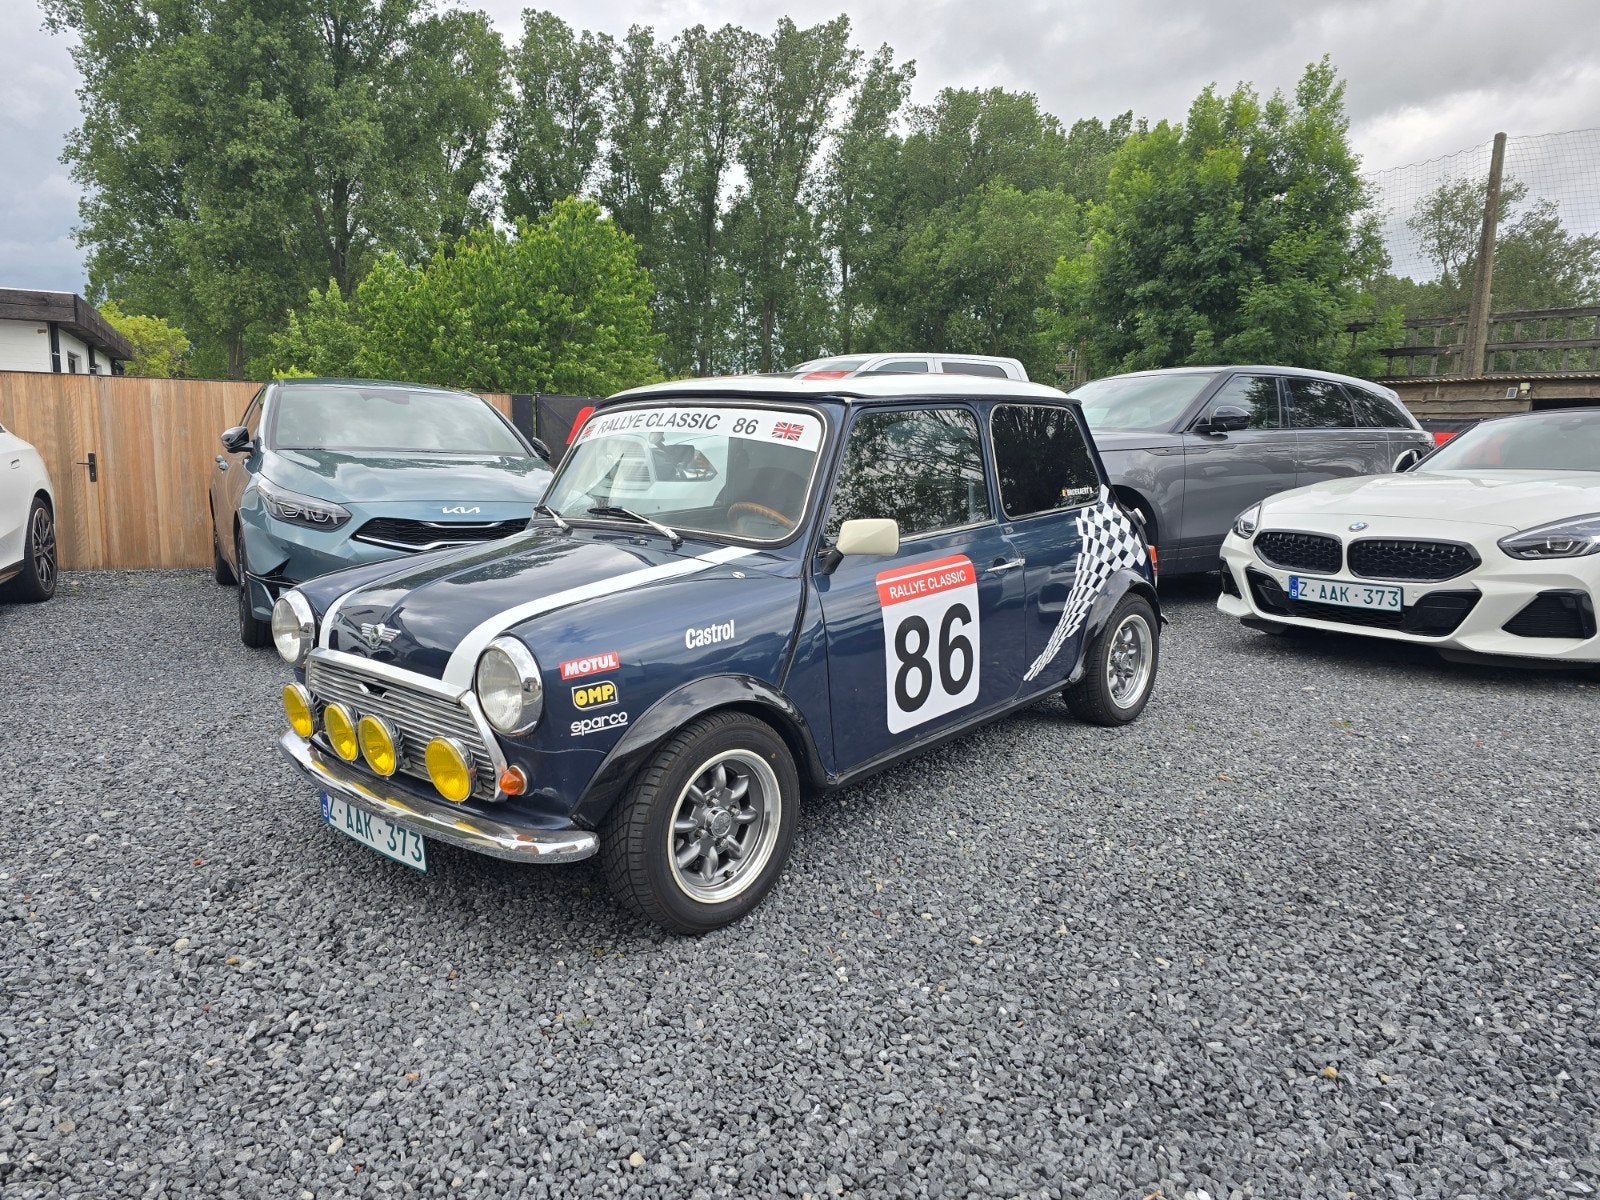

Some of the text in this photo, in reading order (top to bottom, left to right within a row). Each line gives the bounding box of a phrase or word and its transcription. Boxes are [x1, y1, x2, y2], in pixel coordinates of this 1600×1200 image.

[597, 412, 759, 435] RALLYE CLASSIC 86
[889, 570, 967, 600] RALLYE CLASSIC
[685, 619, 735, 649] Castrol
[564, 654, 617, 677] MOTUL
[894, 602, 974, 713] 86
[575, 684, 615, 706] OMP
[571, 711, 628, 736] sparco
